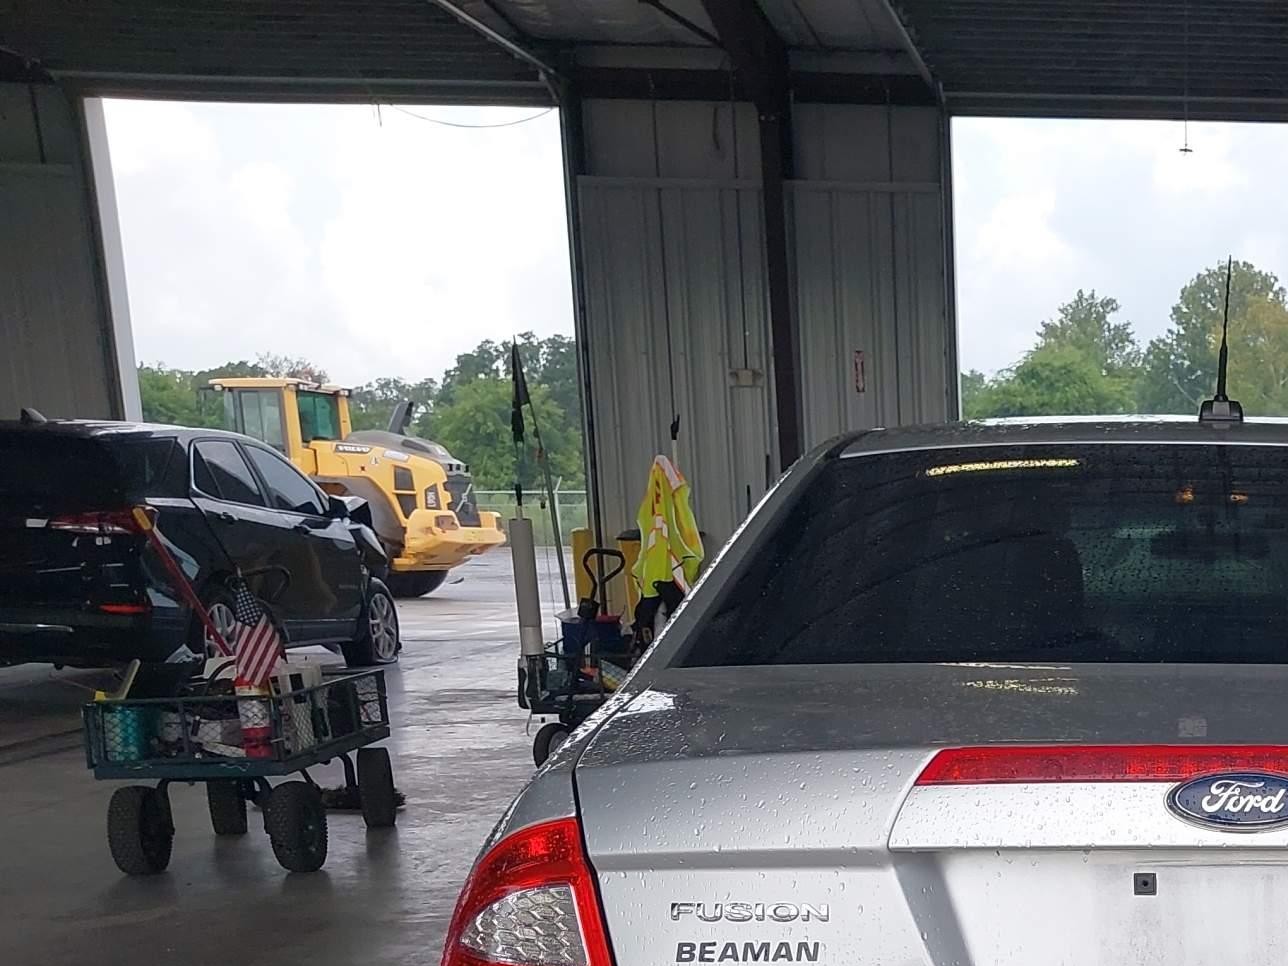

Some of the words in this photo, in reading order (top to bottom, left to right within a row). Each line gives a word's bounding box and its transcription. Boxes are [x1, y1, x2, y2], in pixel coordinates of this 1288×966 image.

[337, 445, 370, 453] VOLVO
[1201, 779, 1286, 813] Ford
[670, 902, 830, 922] FUSION
[675, 941, 820, 963] BEAMAN
